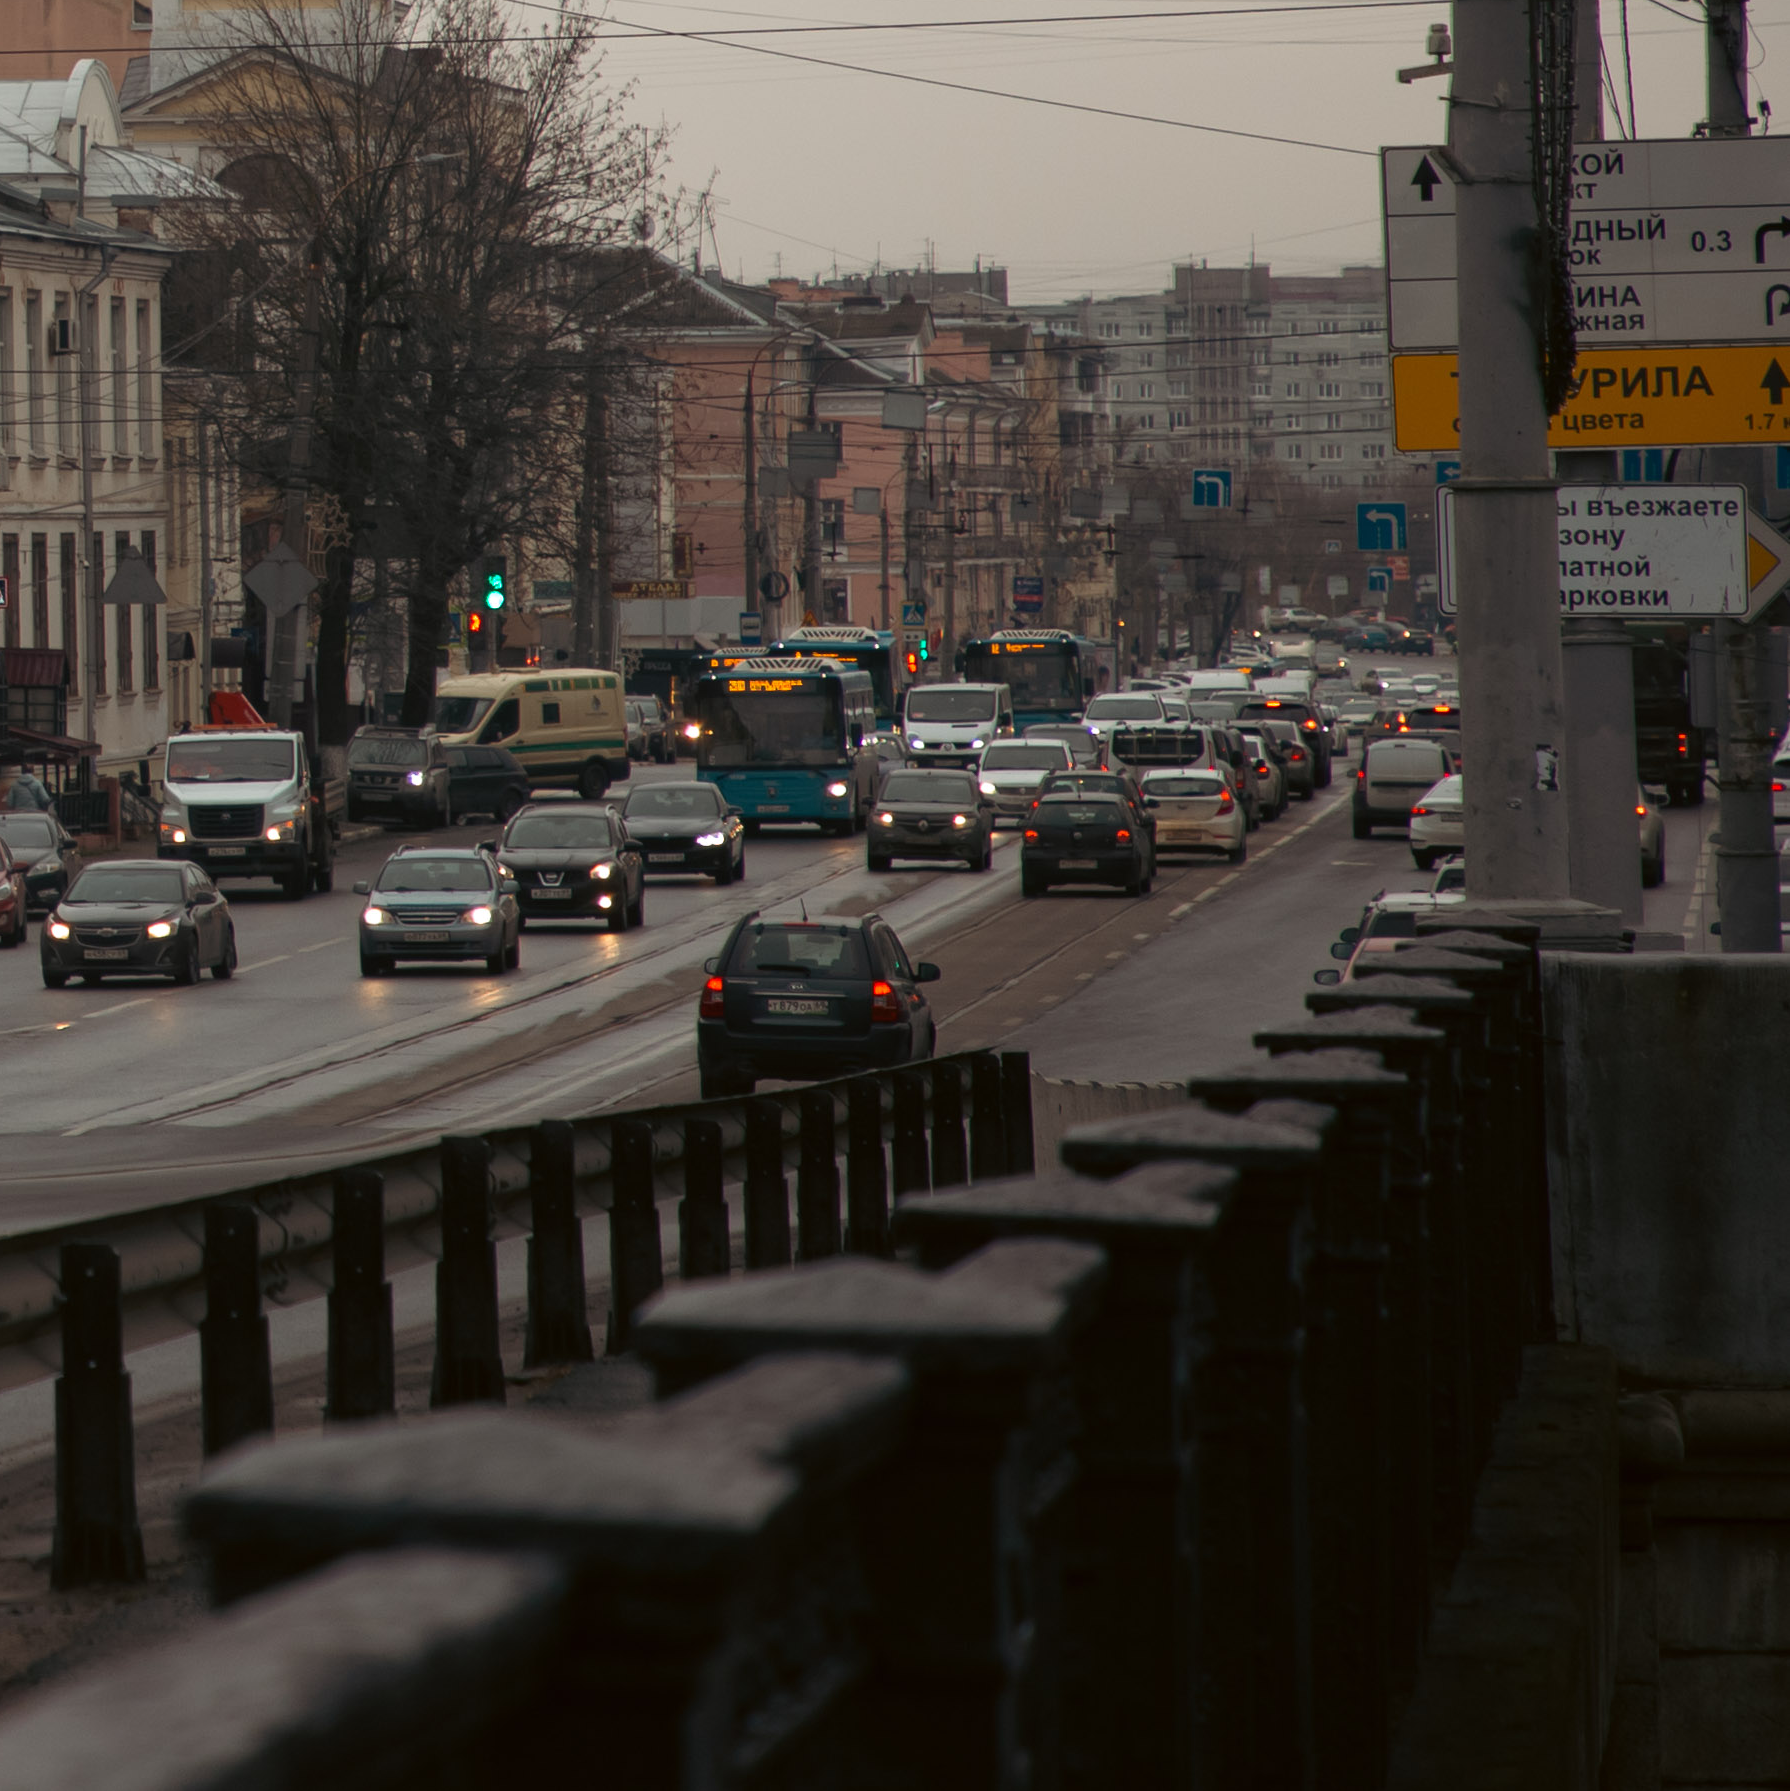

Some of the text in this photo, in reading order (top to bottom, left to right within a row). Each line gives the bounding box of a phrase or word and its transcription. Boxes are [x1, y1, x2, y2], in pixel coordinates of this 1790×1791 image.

[1691, 230, 1732, 251] 0.3
[1567, 366, 1714, 399] УРИЛА
[1563, 412, 1645, 433] цвета
[1587, 500, 1739, 516] въезжаете
[1559, 529, 1625, 551] зону
